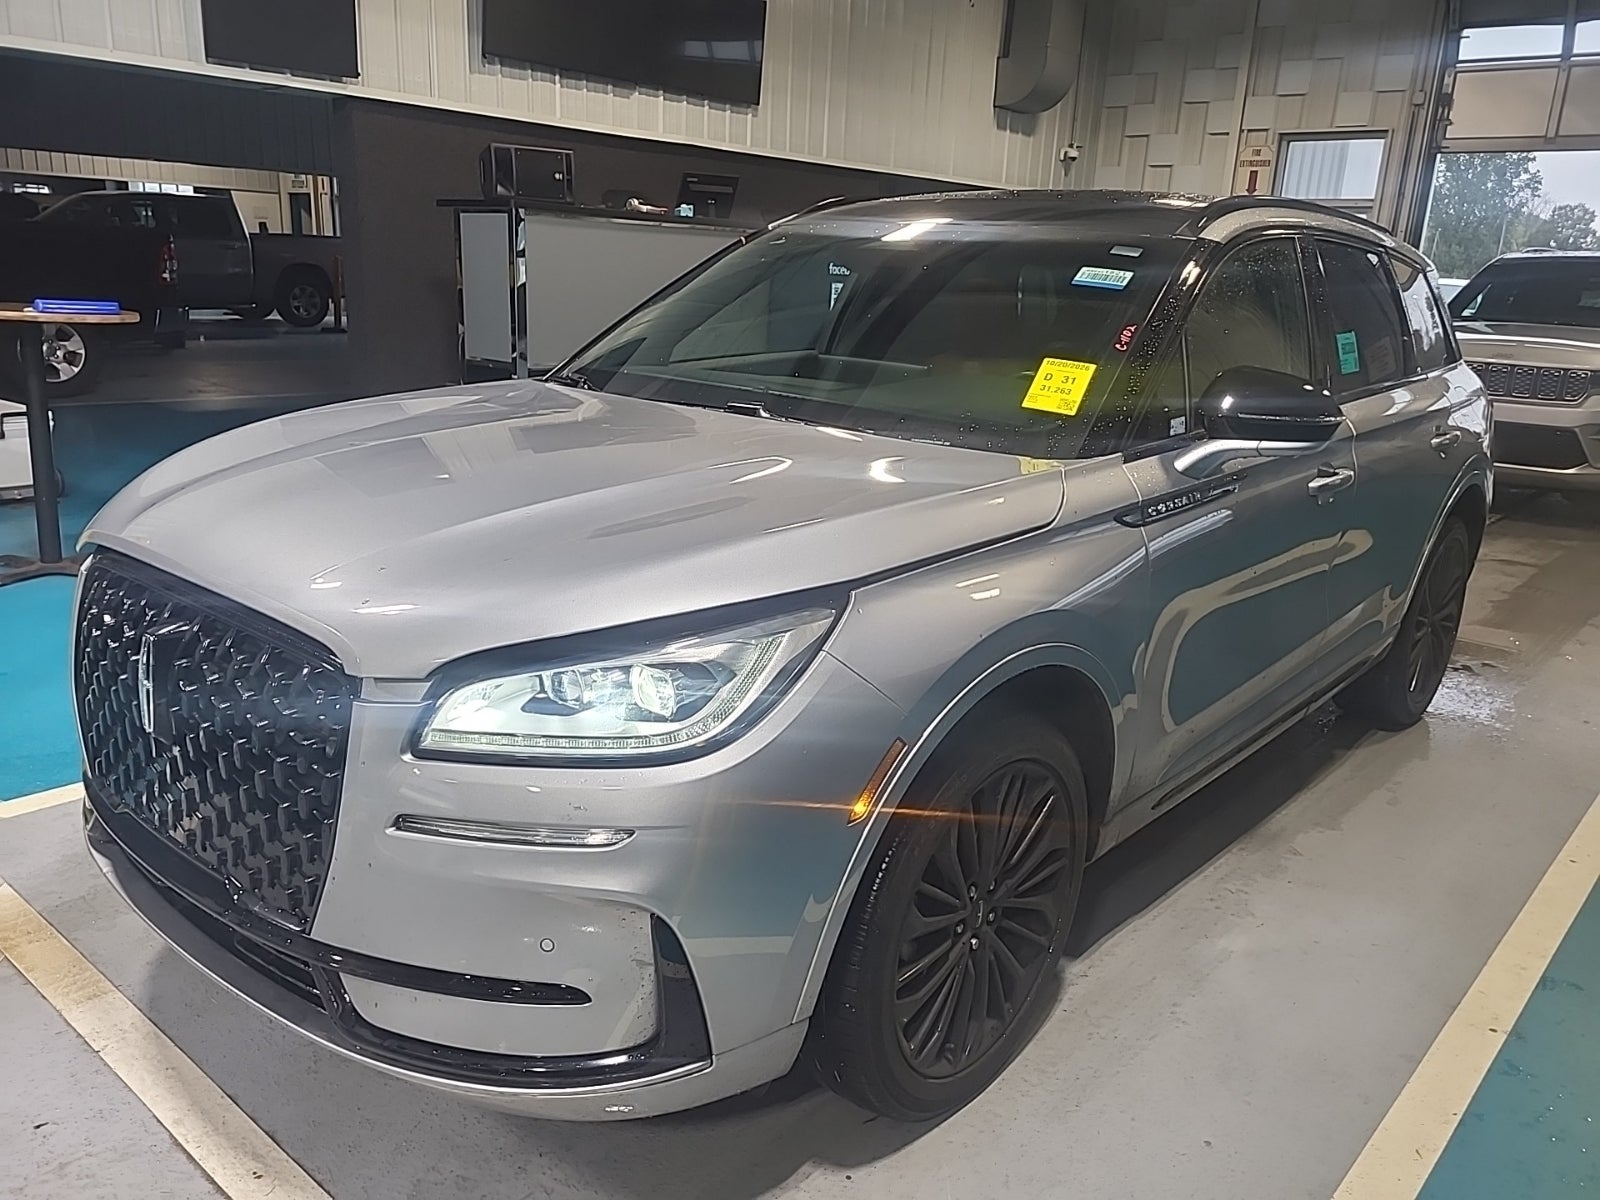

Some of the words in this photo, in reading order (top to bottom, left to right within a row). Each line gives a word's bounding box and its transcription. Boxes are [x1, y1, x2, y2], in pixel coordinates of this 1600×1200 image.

[1043, 372, 1054, 382] D
[1061, 375, 1077, 385] 31
[1148, 492, 1201, 516] CORSAIR
